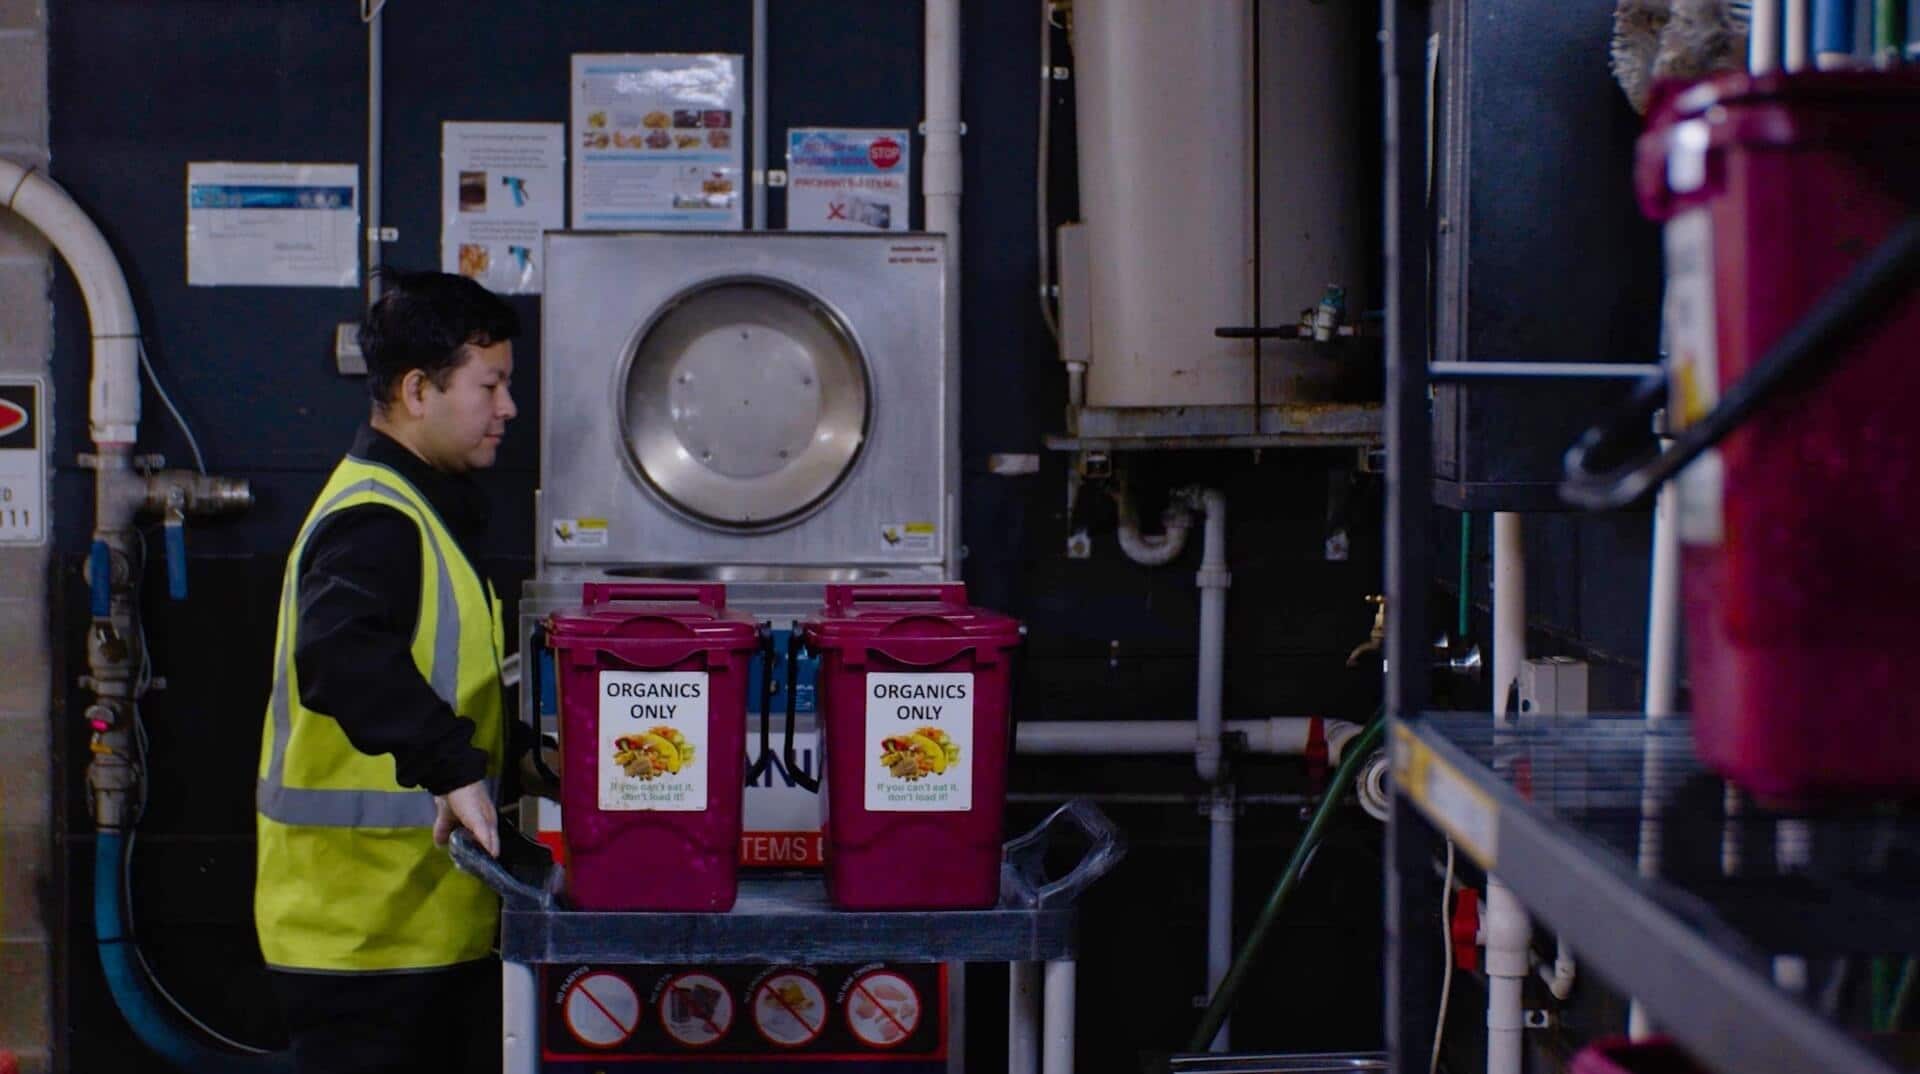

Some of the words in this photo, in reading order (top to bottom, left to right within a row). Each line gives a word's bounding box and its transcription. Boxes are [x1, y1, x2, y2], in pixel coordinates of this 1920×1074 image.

[871, 147, 899, 159] STOP
[607, 682, 701, 698] ORGANICS
[874, 684, 966, 699] ORGANICS
[630, 704, 677, 719] ONLY
[896, 705, 943, 720] ONLY
